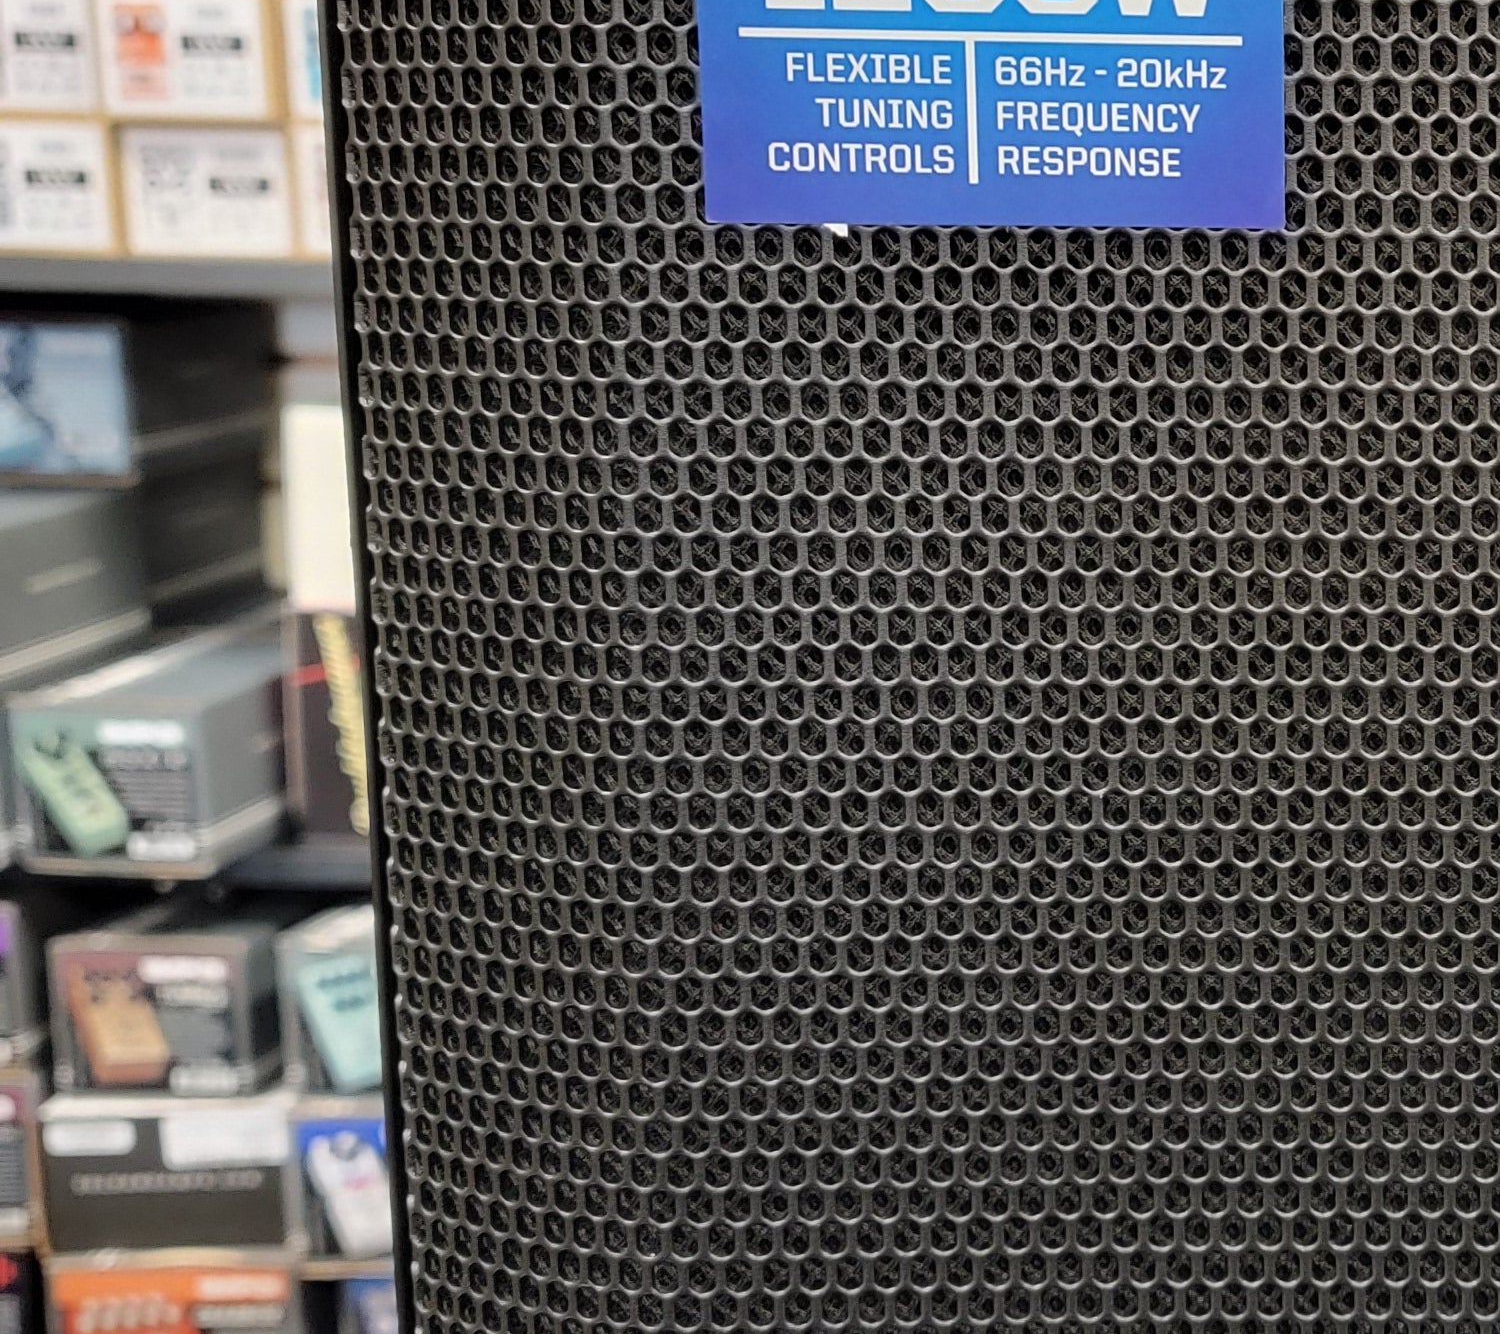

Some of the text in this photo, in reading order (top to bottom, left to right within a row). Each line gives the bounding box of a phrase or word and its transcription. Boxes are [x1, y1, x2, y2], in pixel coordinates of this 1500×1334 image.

[785, 52, 952, 85] FLEXIBLE
[995, 56, 1087, 88] 66Hz
[1116, 57, 1228, 90] 20kHz
[815, 97, 953, 130] TUNING
[997, 101, 1201, 137] FREQUENCY
[767, 142, 955, 175] CONTROLS
[998, 146, 1182, 178] RESPONSE
